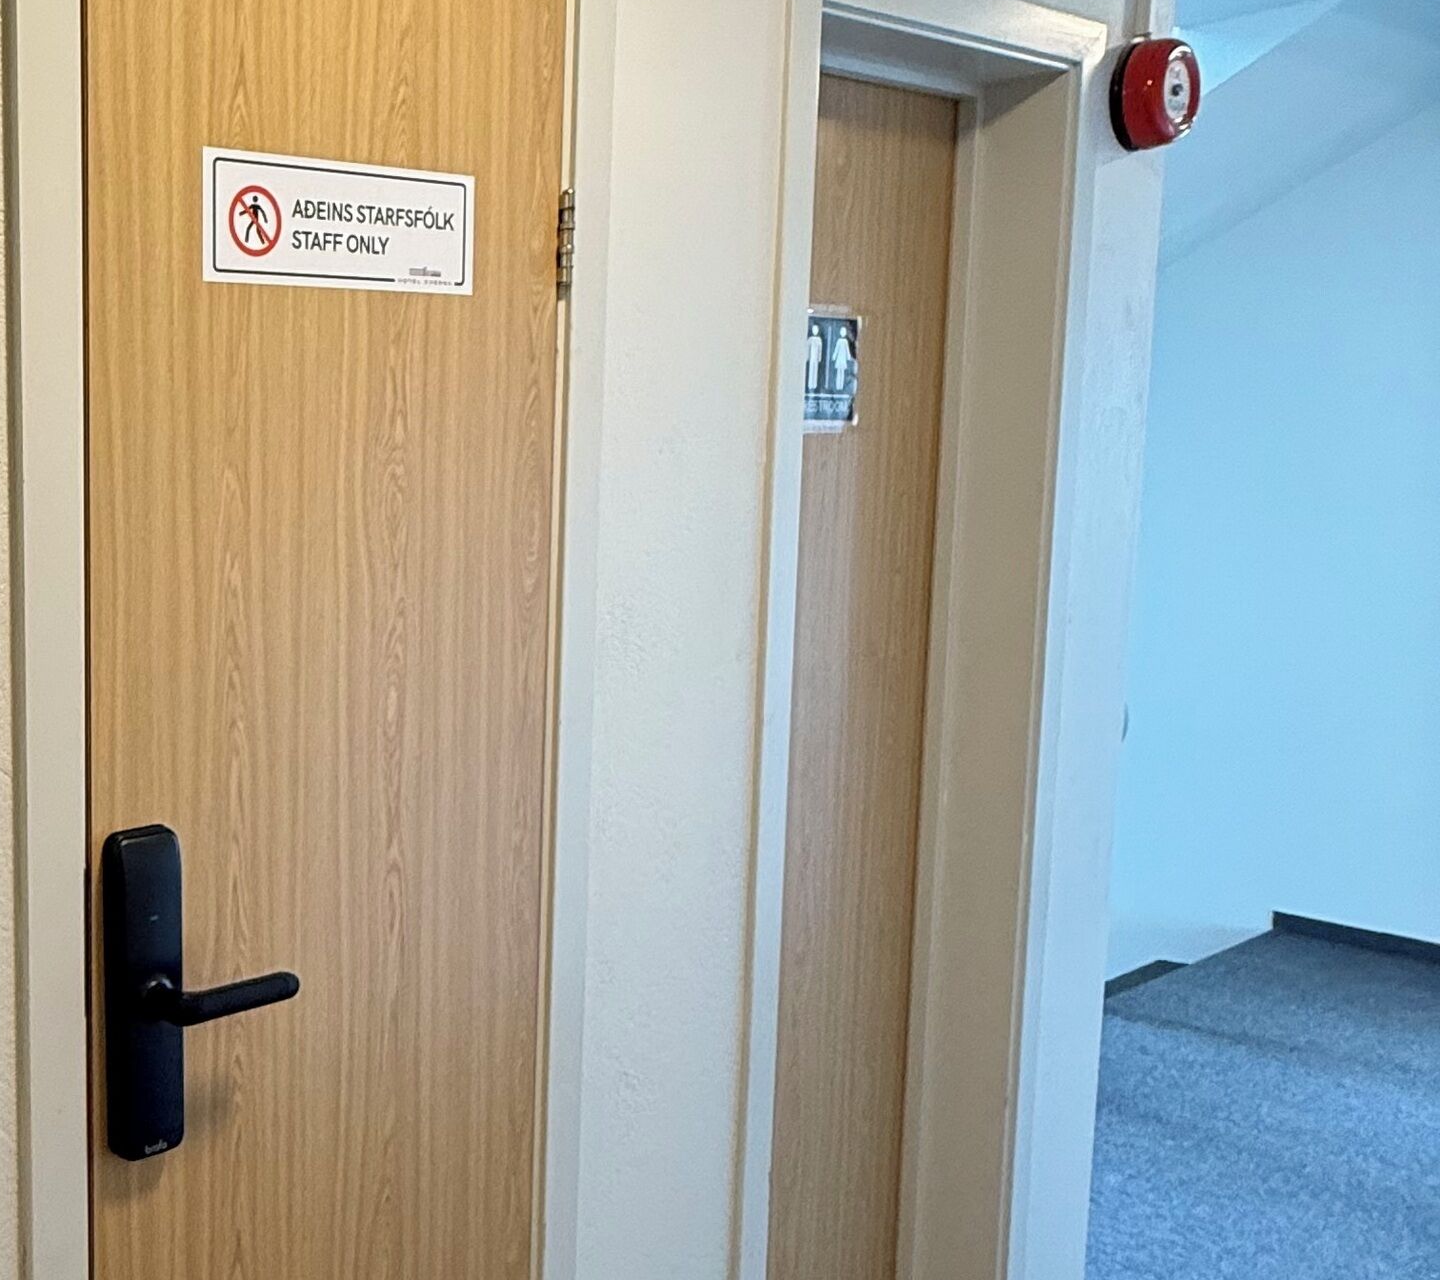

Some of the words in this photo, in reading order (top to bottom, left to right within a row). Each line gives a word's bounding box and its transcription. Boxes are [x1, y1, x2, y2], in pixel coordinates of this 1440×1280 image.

[291, 198, 353, 223] AÐEINS
[356, 204, 455, 231] STARFSFÓLK
[291, 230, 343, 252] STAFF
[346, 234, 390, 255] ONLY
